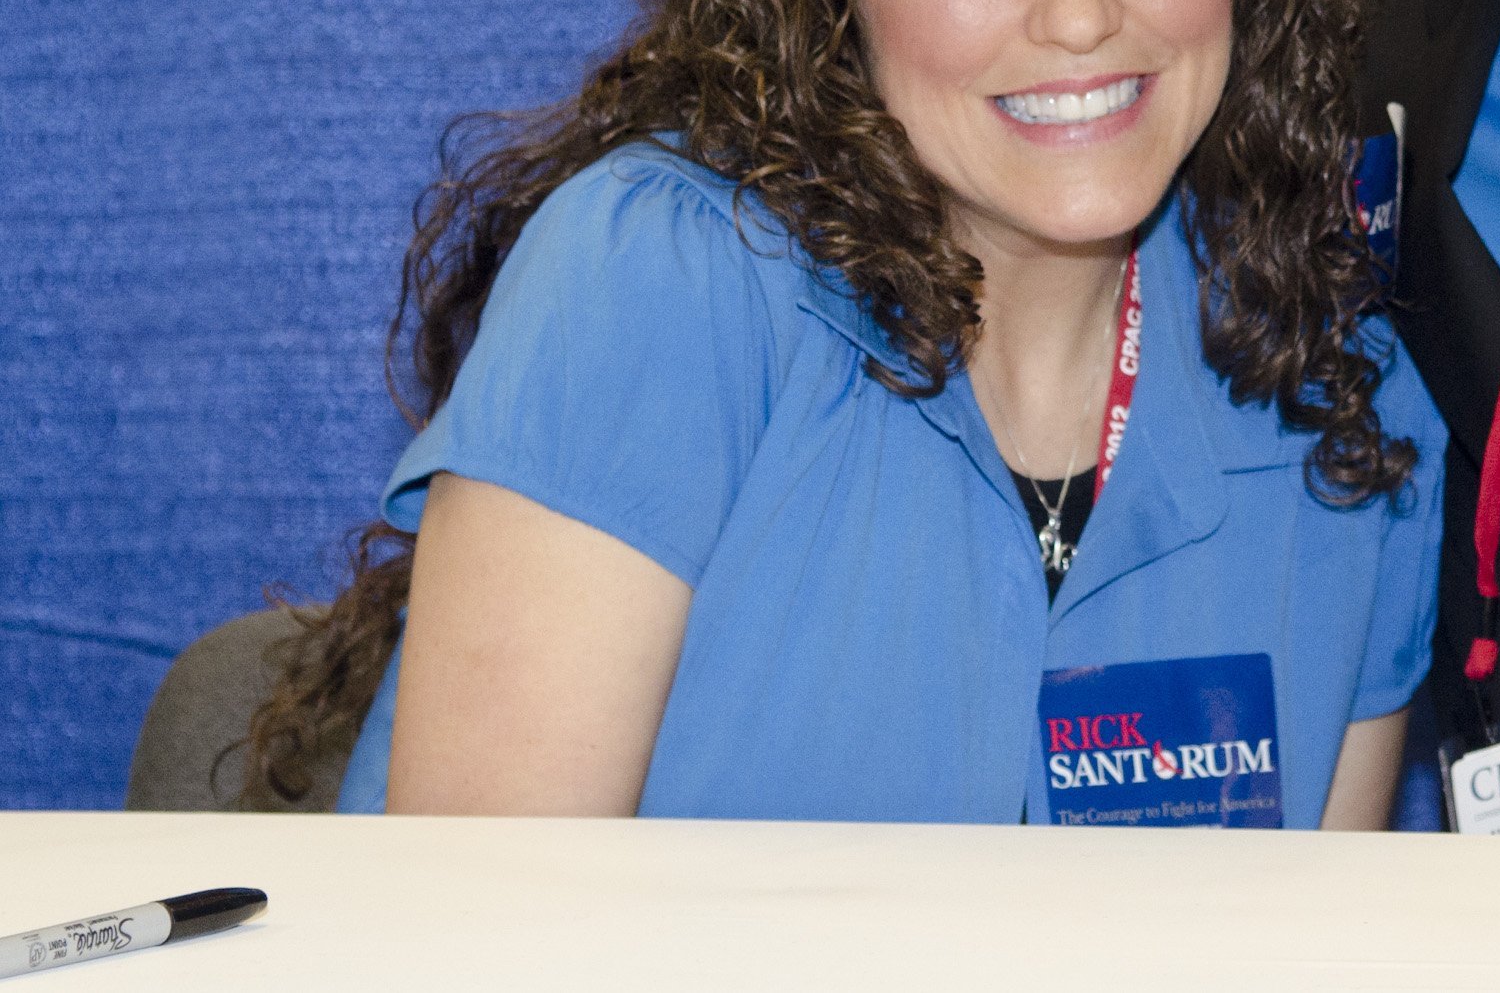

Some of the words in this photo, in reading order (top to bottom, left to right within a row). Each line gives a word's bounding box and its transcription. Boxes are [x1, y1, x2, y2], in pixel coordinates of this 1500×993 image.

[1119, 306, 1142, 376] CPAC
[1105, 404, 1130, 462] 2012
[1047, 712, 1147, 753] RICK
[1049, 738, 1273, 790] SANTORUM
[1057, 809, 1085, 825] The
[1086, 806, 1143, 824] Courage
[1146, 806, 1160, 818] to
[1161, 801, 1195, 818] Fight
[1197, 800, 1216, 813] for
[49, 938, 68, 951] POINT
[53, 948, 68, 959] FINE
[76, 917, 134, 956] Sharpie
